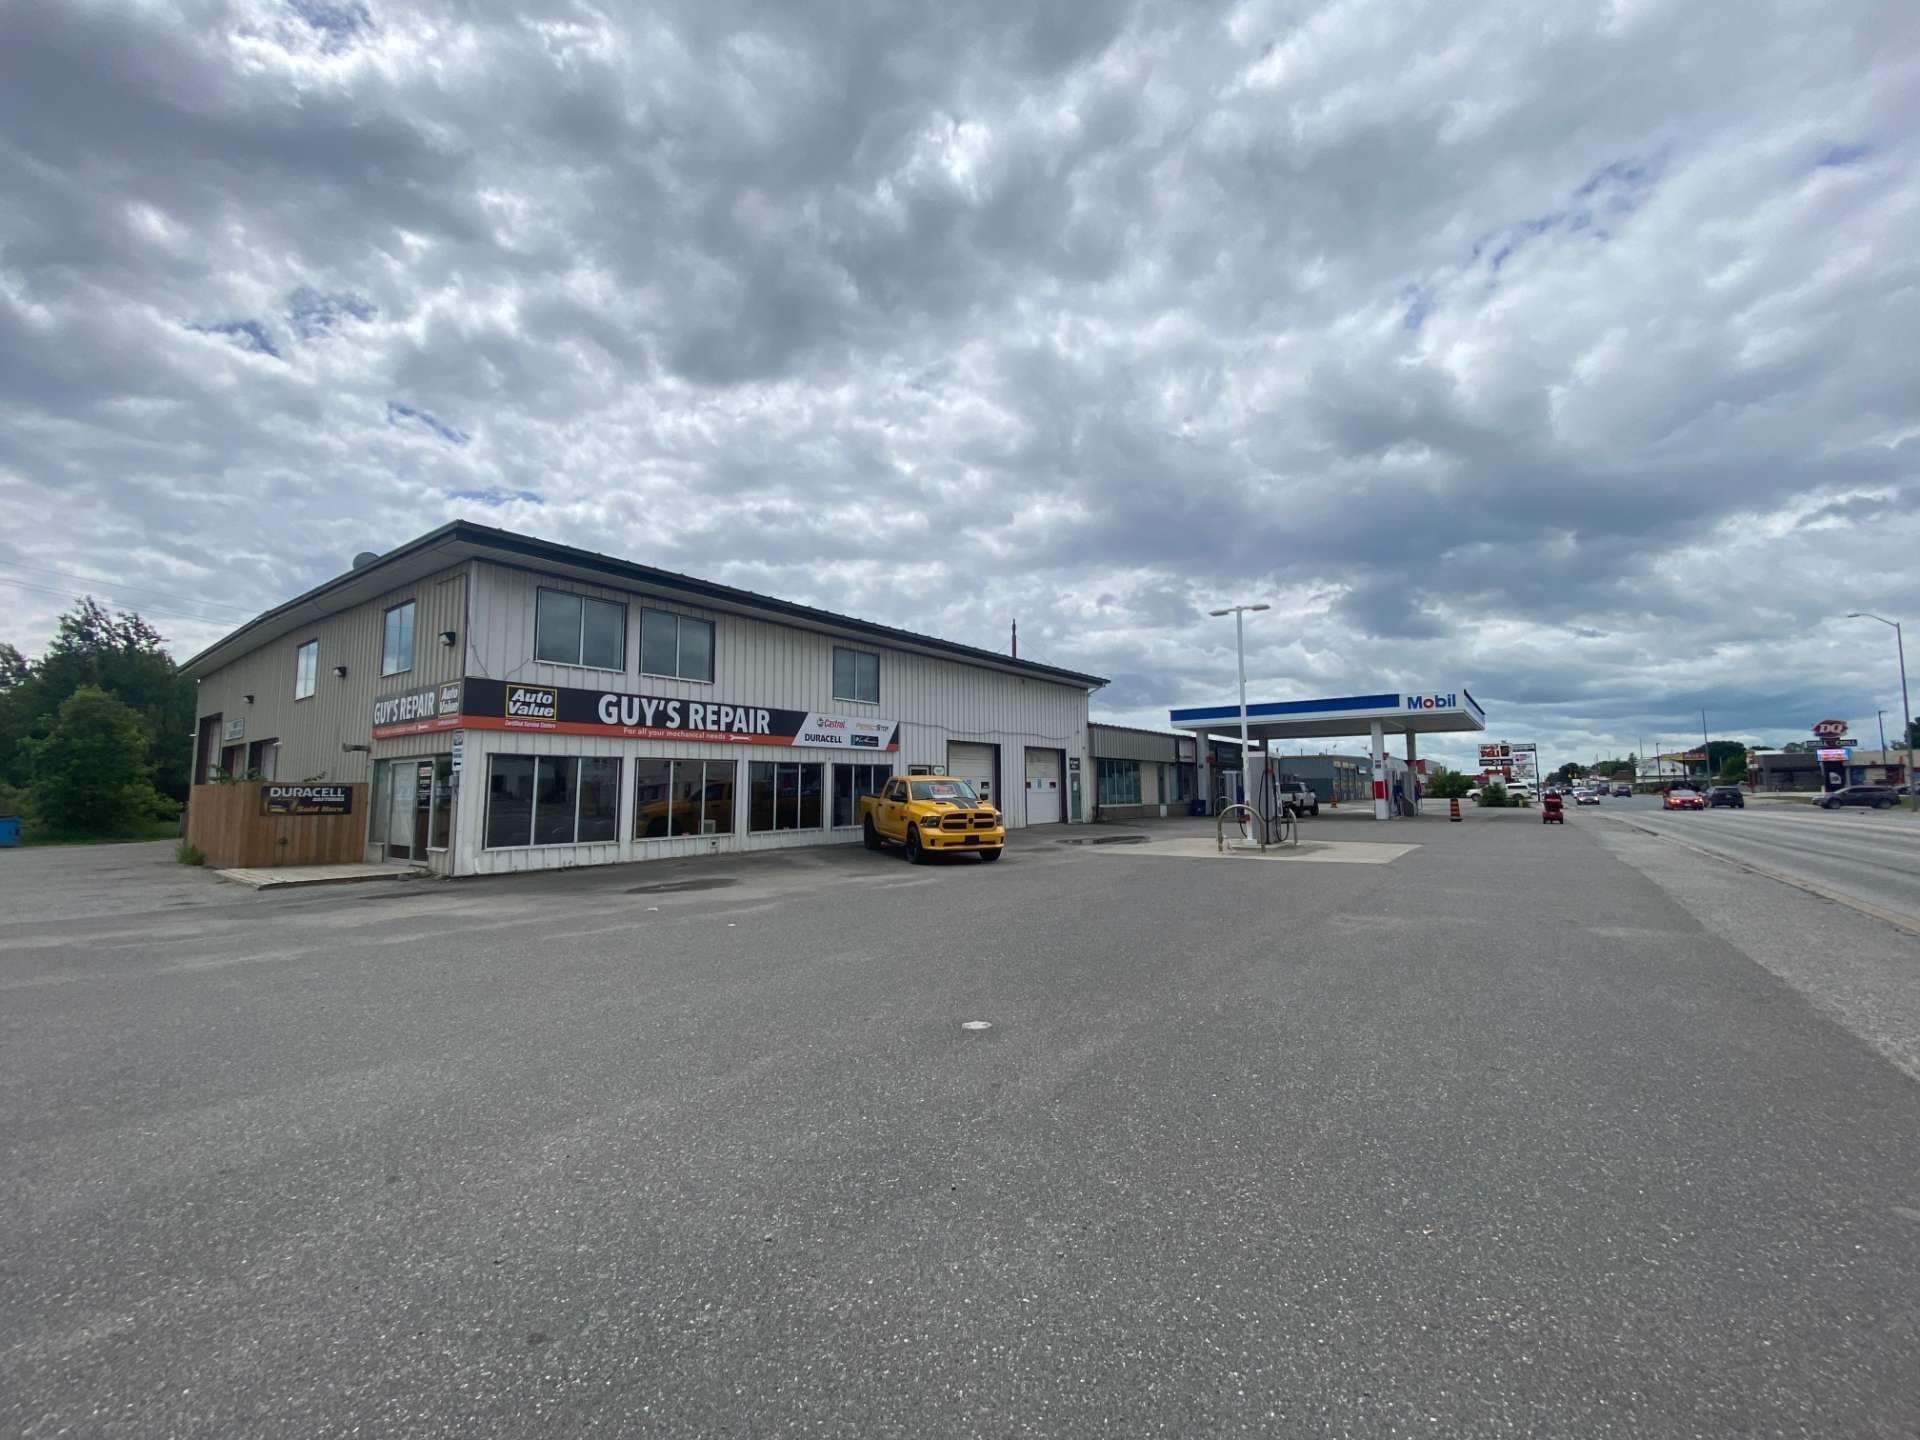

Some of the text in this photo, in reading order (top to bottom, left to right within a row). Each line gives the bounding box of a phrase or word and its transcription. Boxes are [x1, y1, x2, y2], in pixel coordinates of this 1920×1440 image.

[511, 689, 553, 704] Auto
[1407, 693, 1456, 709] Mobil
[374, 692, 435, 724] GUY'S REPAIR
[509, 701, 555, 717] Value
[598, 694, 770, 734] GUY'S REPAIR
[623, 727, 636, 735] For
[666, 731, 705, 739] mechanical
[1820, 724, 1842, 734] DQ
[804, 734, 842, 743] DURACELL
[270, 787, 345, 797] DURACELL
